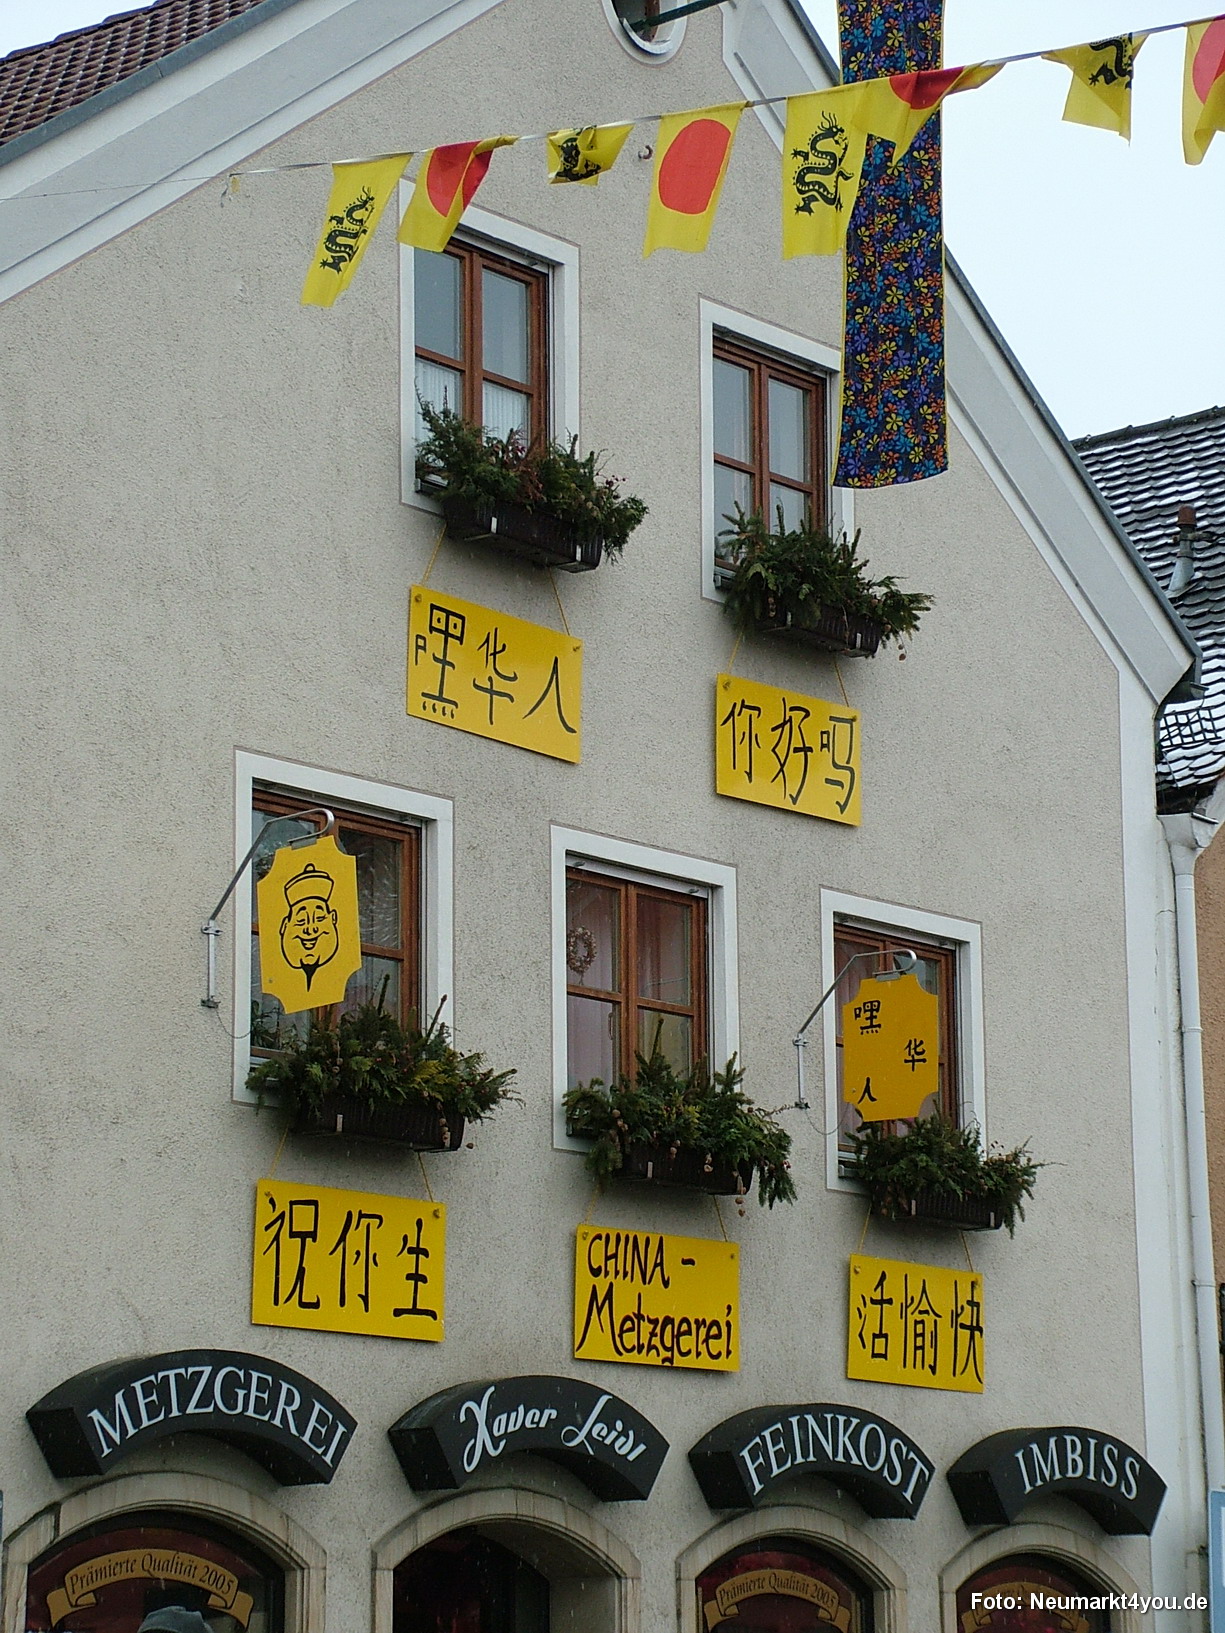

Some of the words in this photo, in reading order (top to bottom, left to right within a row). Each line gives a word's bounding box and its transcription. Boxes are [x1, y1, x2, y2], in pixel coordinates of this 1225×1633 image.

[720, 696, 856, 815] 你好吗
[263, 1196, 438, 1321] 祝你生
[587, 1231, 671, 1290] CHINA
[575, 1281, 733, 1367] Metzgerei
[857, 1270, 984, 1385] 活愉快
[87, 1365, 348, 1469] METZGEREI
[459, 1385, 557, 1474] Xaver
[560, 1393, 648, 1463] Leidl
[739, 1412, 930, 1505] FEINKOST
[1014, 1433, 1141, 1500] IMBISS
[69, 1558, 137, 1595] Prämierte
[140, 1551, 198, 1579] Qualität
[199, 1564, 235, 1596] 2005
[719, 1576, 766, 1606] Prämierte
[810, 1583, 837, 1609] 2005
